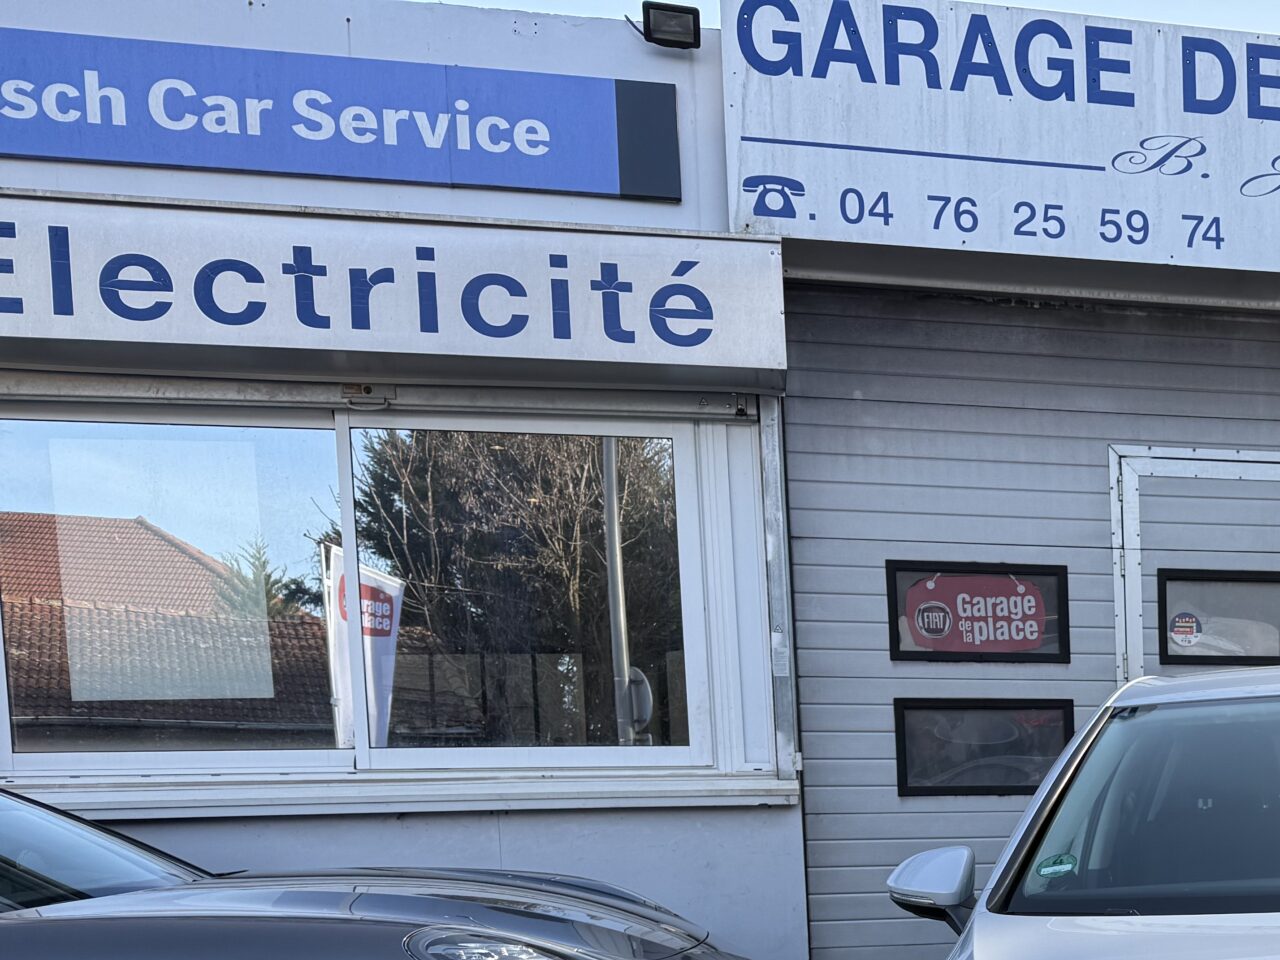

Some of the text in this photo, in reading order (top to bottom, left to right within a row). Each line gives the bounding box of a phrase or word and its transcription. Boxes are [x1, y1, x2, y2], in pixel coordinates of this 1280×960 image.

[736, 0, 1136, 108] GARAGE
[148, 77, 273, 137] Car
[291, 88, 551, 157] Service
[1110, 135, 1211, 180] B.
[839, 187, 1226, 251] 04 76 25 59 74
[923, 611, 945, 630] FIAT
[956, 592, 1036, 620] Garage
[958, 618, 972, 632] de
[963, 630, 973, 643] la
[973, 617, 1039, 646] place
